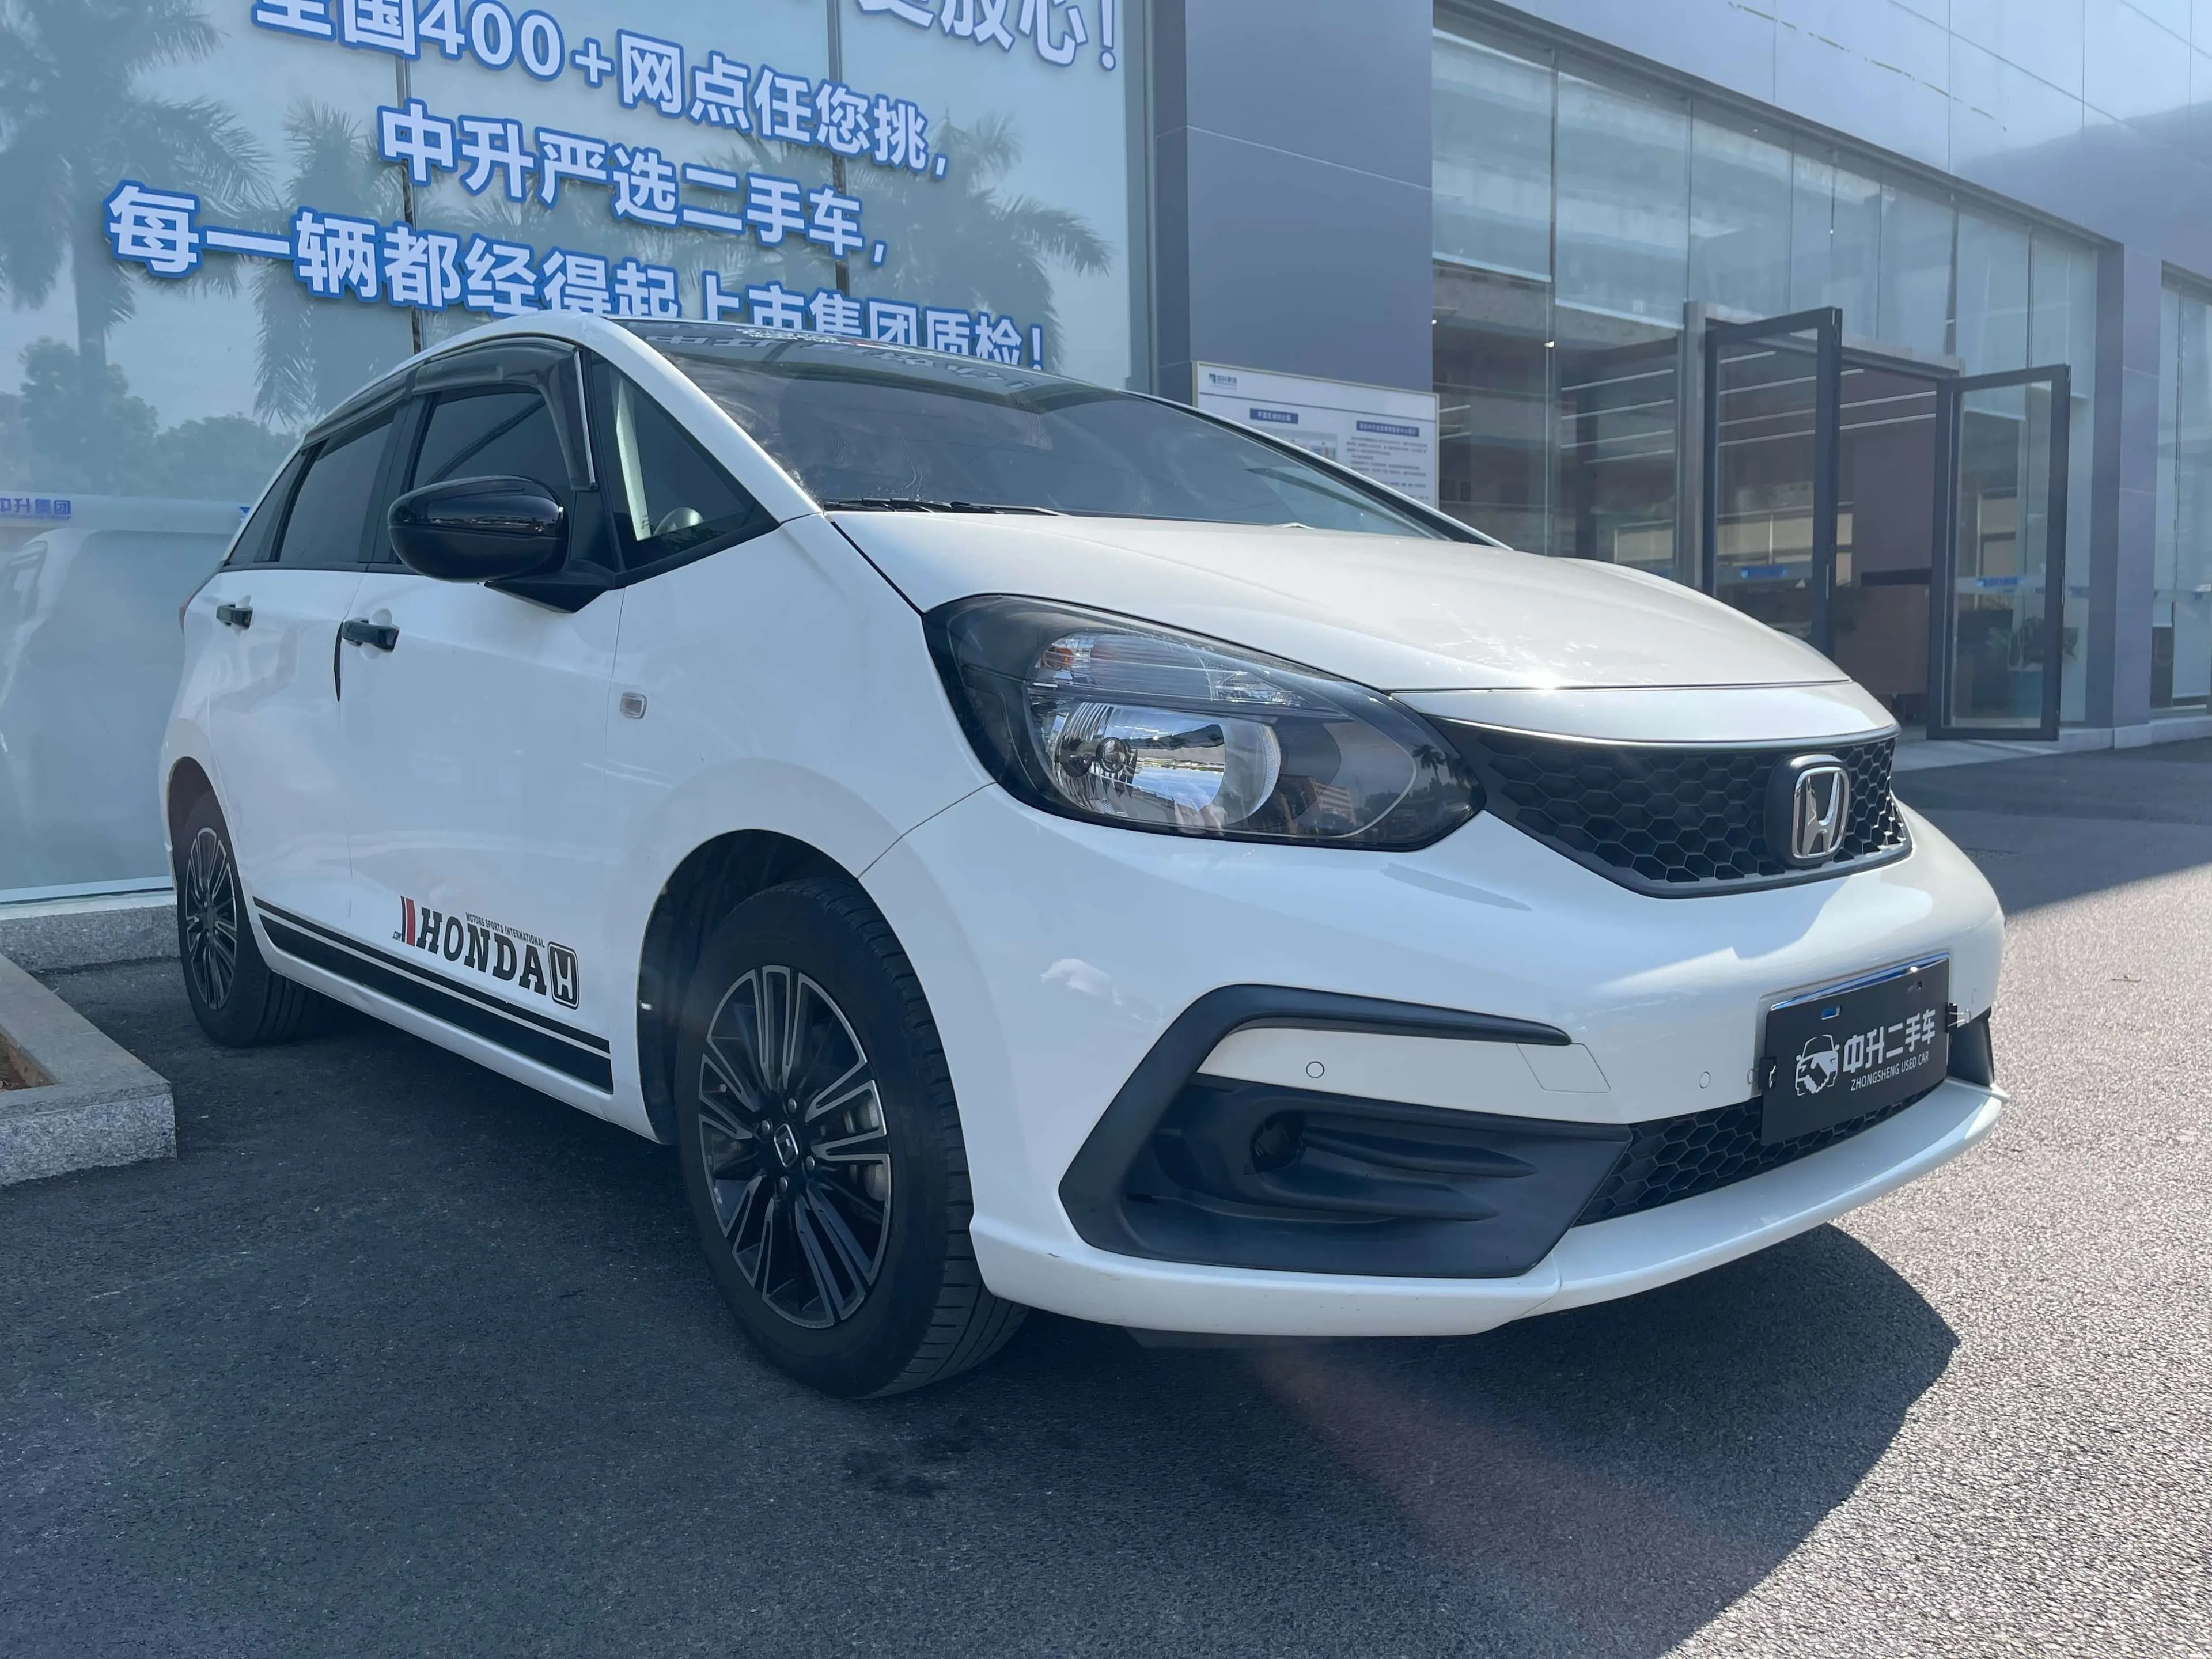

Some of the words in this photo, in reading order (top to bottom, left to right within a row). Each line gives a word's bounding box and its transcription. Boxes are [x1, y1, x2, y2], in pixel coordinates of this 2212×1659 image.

[379, 99, 888, 266] 中升严选二手车,
[416, 907, 547, 996] HONDA
[465, 912, 484, 926] MOTORS
[484, 919, 504, 934] SPORTS
[504, 926, 545, 948] INTERNATIONAL
[1843, 1009, 1936, 1074] 中升二手车
[1850, 1063, 1900, 1092] ZHONGSHENG
[1901, 1056, 1916, 1073] USED
[1918, 1050, 1930, 1065] CAR
